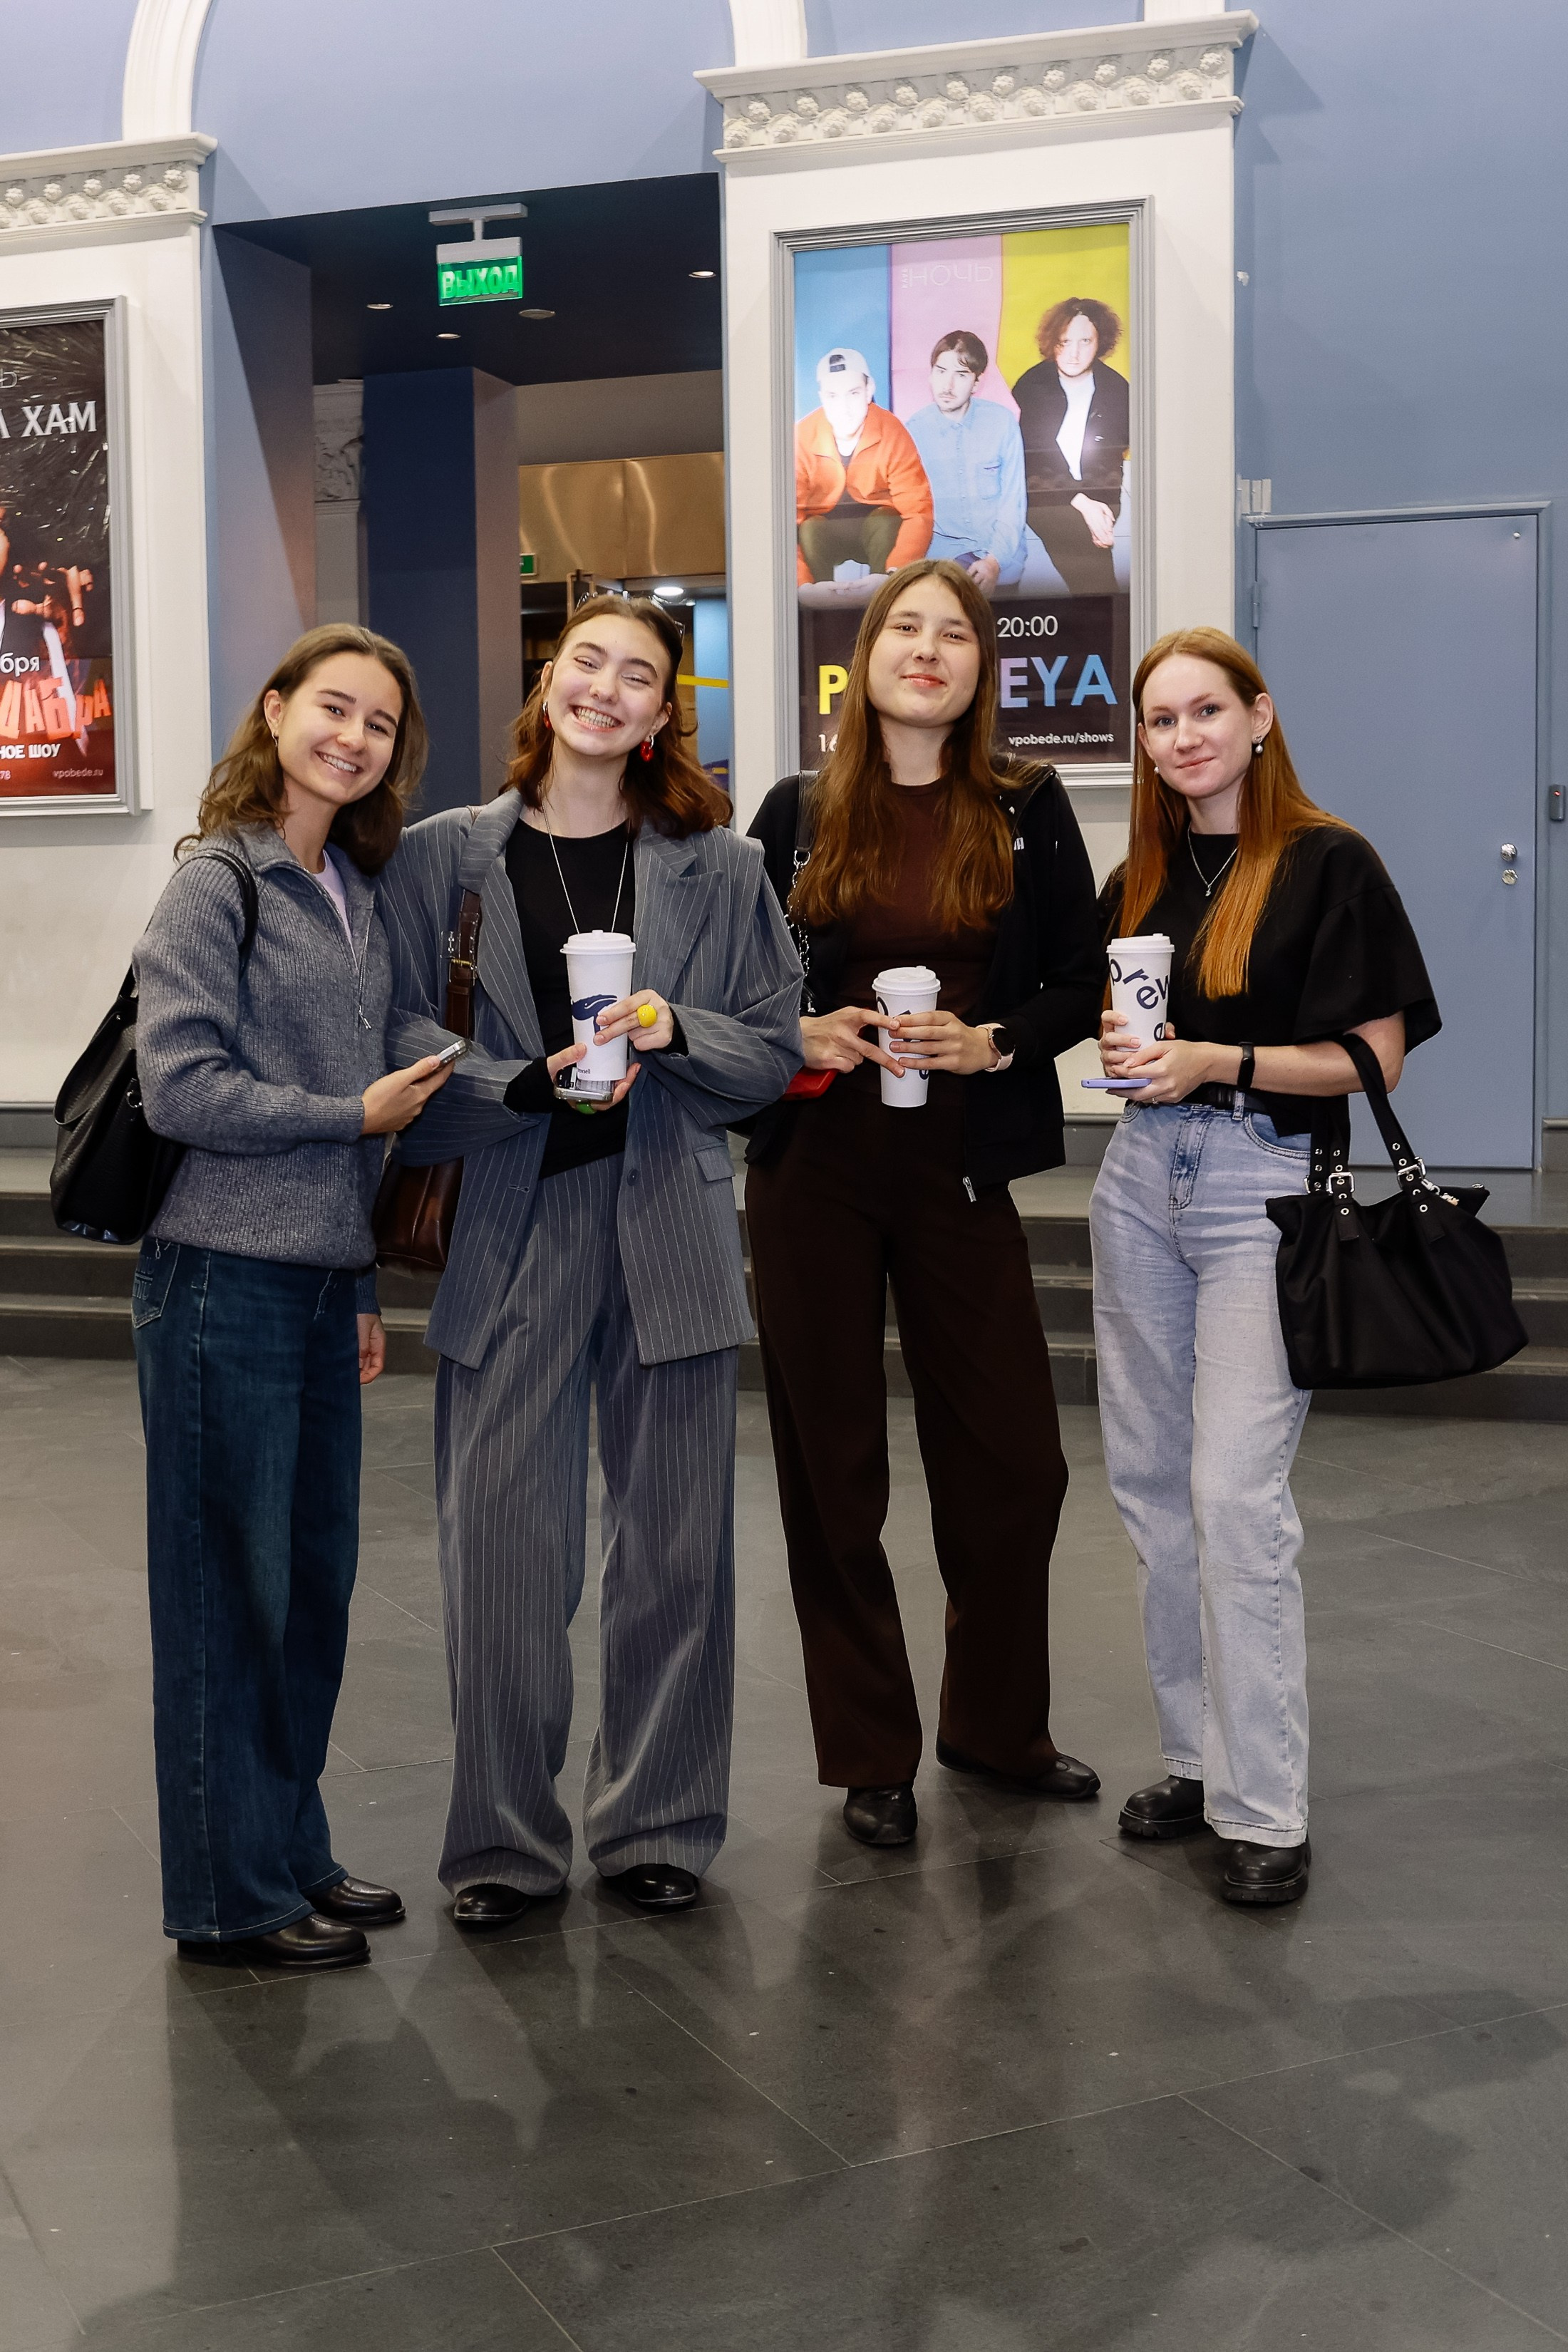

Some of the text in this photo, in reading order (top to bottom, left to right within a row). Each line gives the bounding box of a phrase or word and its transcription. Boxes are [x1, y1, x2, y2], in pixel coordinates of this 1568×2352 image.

[441, 264, 519, 299] ВЫХОД
[908, 262, 994, 287] НОЧЬ
[21, 401, 97, 438] ХАМ
[997, 615, 1058, 638] 20:00
[28, 743, 61, 758] ШОУ
[1008, 731, 1115, 747] vpobede.ru/shows
[53, 768, 103, 779] vpobede.ru
